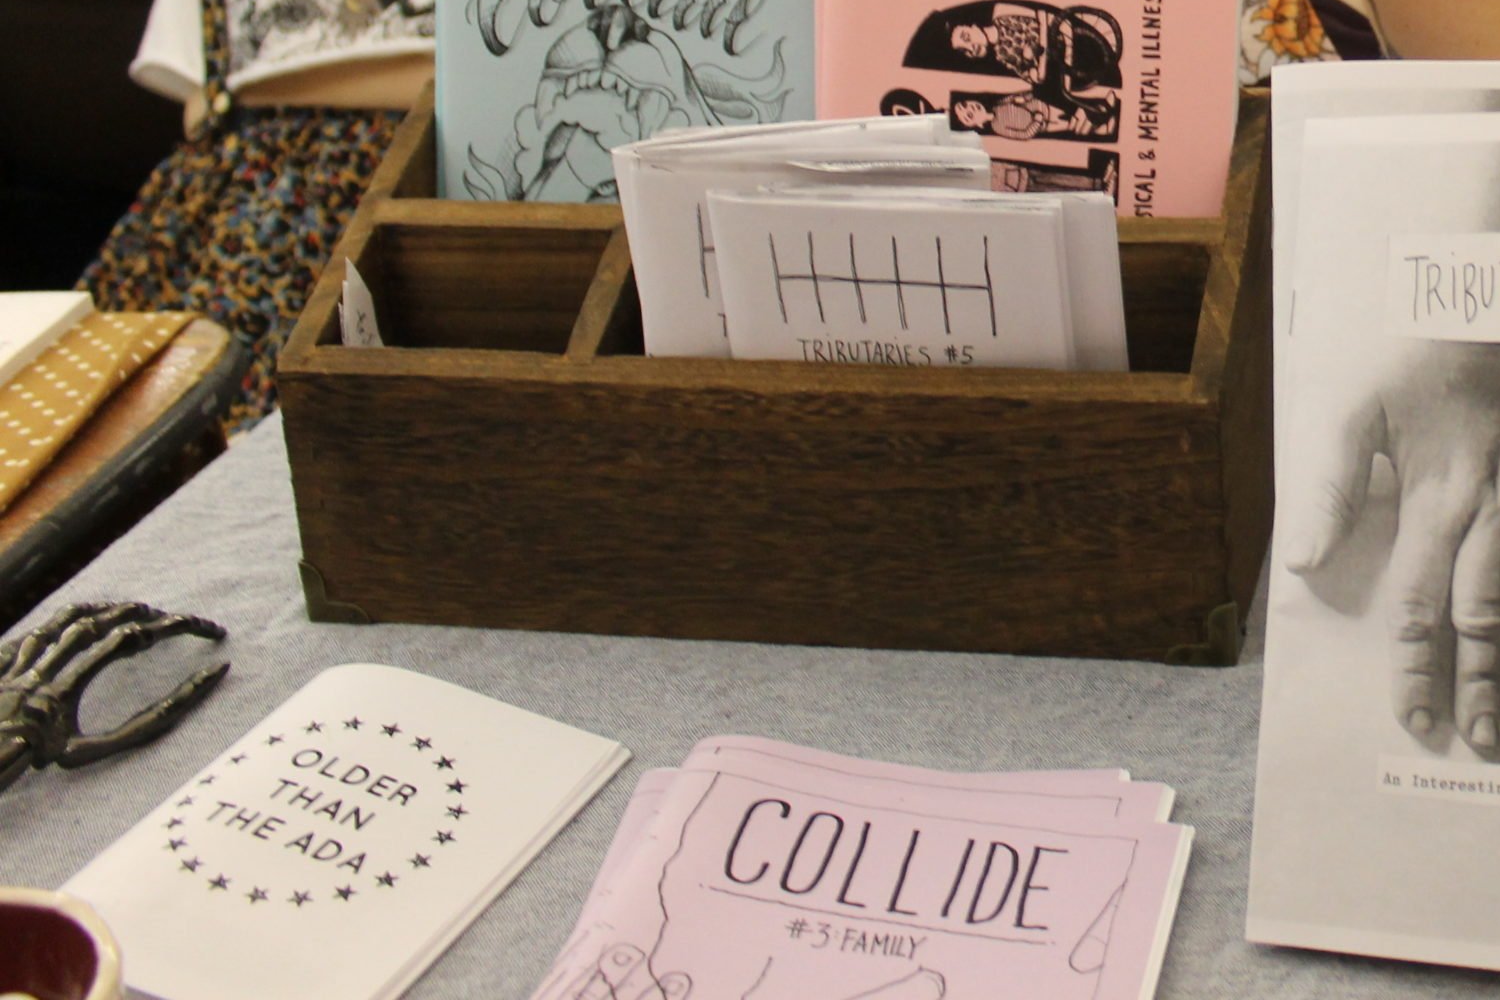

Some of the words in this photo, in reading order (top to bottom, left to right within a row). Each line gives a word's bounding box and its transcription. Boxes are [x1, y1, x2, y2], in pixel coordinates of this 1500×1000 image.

[1138, 68, 1161, 142] MENTAL
[1134, 168, 1157, 217] SICAL
[944, 344, 974, 365] #5
[269, 777, 376, 831] THAN
[290, 748, 418, 806] OLDER
[1382, 772, 1401, 787] An
[206, 800, 287, 840] THE
[284, 831, 368, 874] ADA
[723, 798, 1070, 932] COLLIDE
